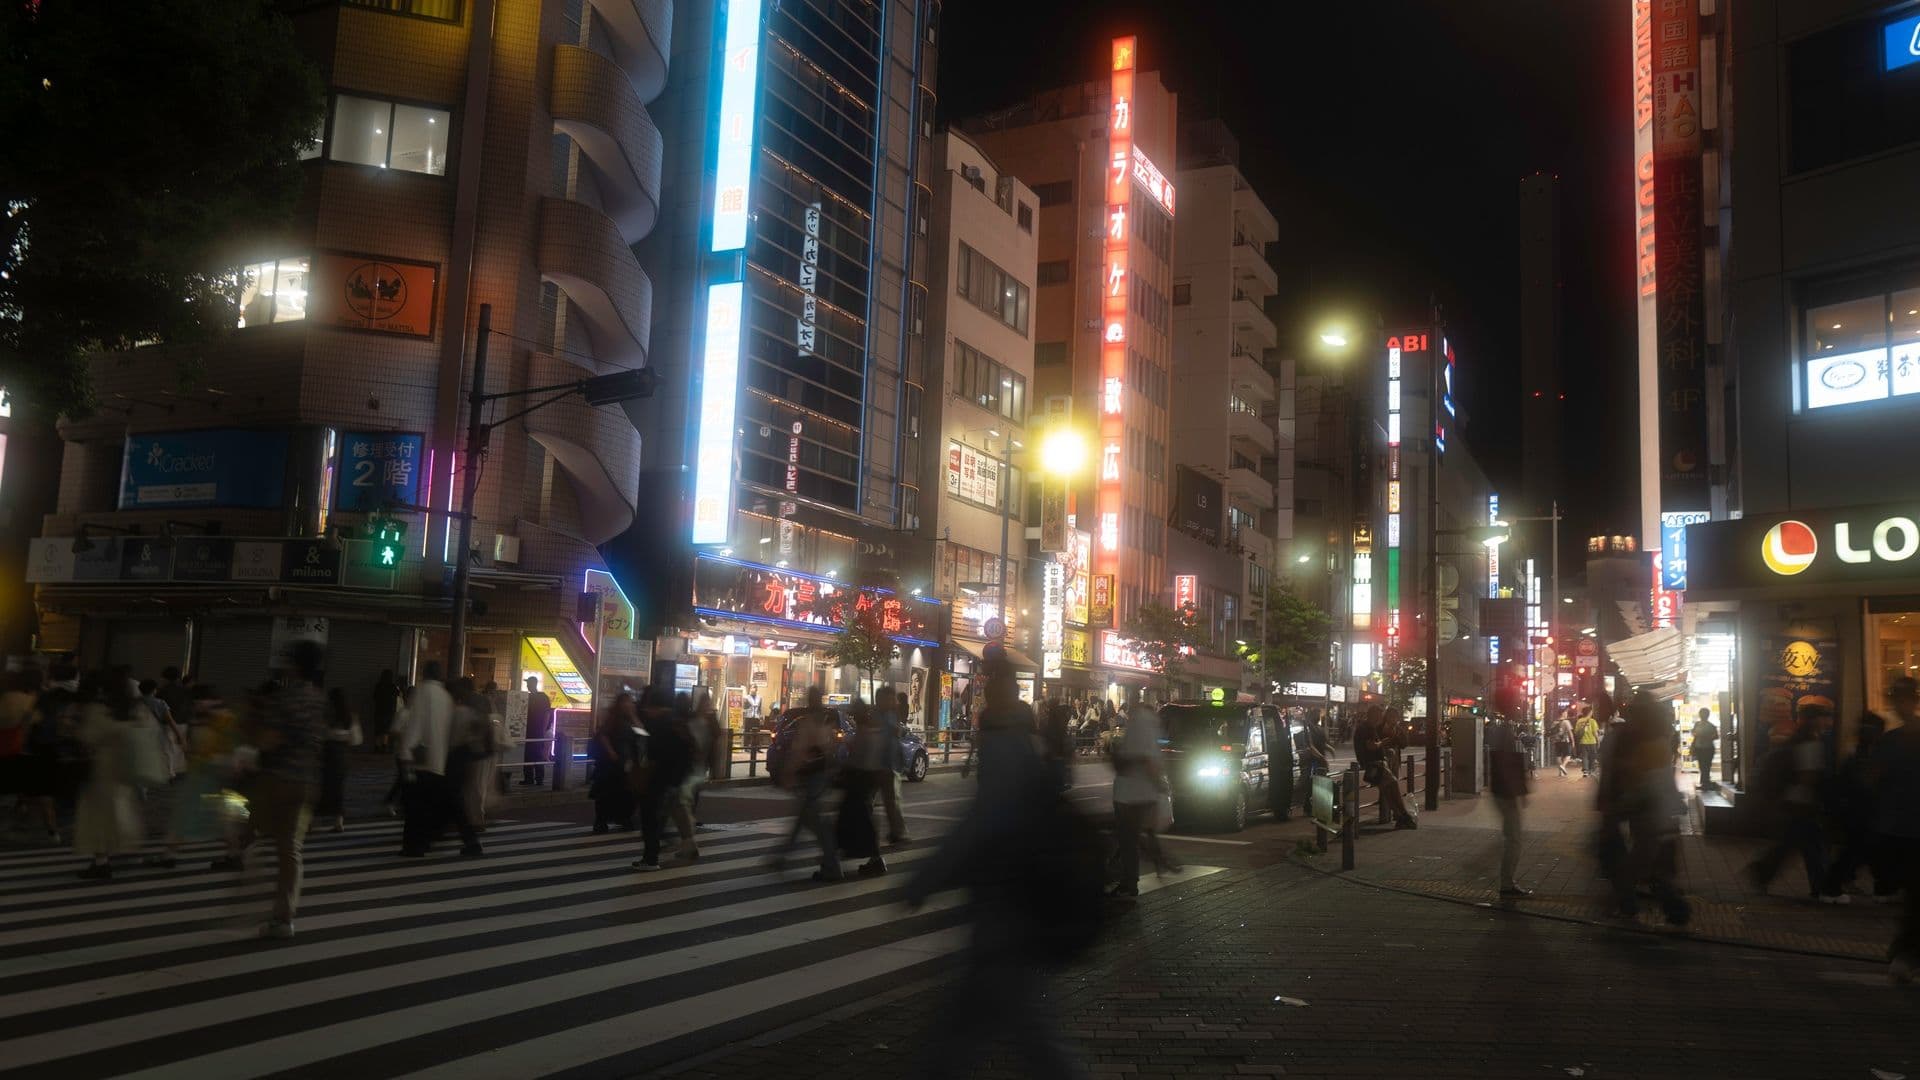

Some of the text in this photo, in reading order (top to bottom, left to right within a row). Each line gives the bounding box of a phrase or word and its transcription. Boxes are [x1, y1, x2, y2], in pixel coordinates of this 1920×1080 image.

[353, 441, 415, 458] 修理受付
[1667, 515, 1705, 526] AEON
[1835, 516, 1920, 564] LO
[1669, 528, 1687, 587] イーオン
